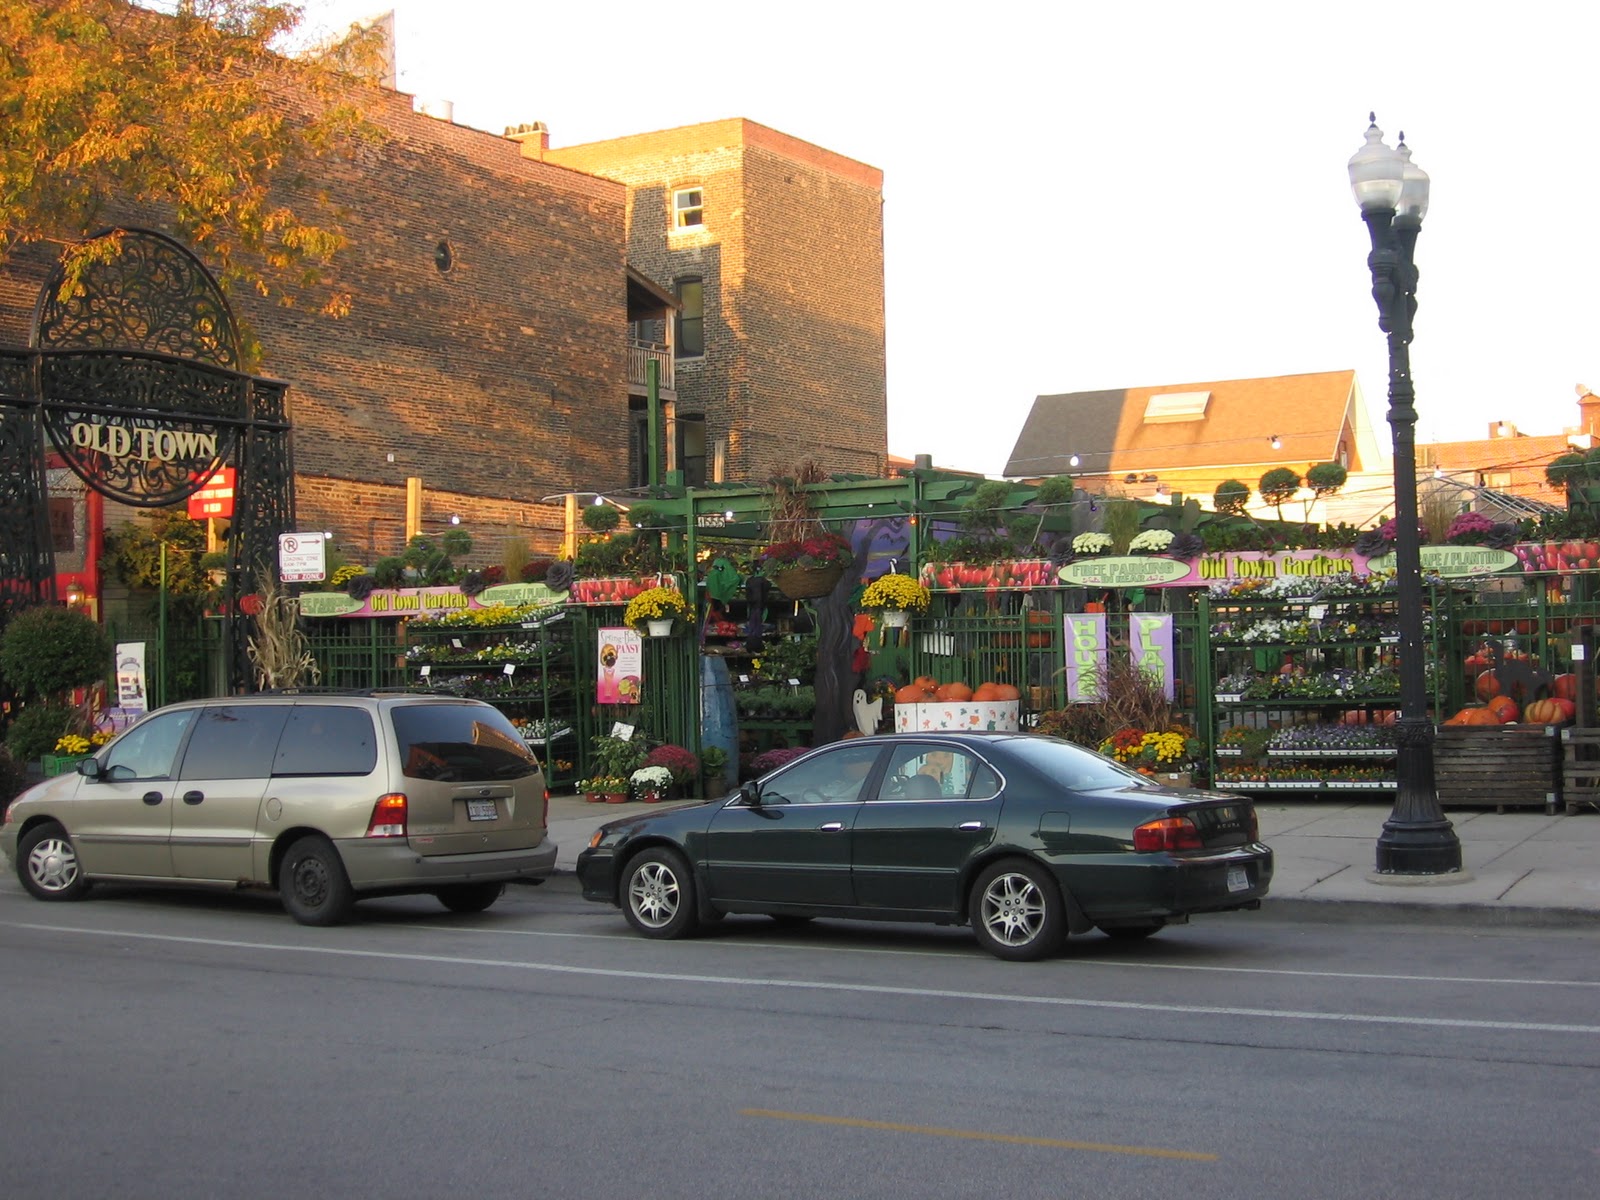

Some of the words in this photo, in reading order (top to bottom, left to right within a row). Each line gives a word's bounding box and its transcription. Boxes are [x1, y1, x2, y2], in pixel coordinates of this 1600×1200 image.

[72, 422, 131, 457] OLD
[134, 427, 218, 462] TOWN
[1450, 551, 1505, 566] PLANTING
[1072, 564, 1107, 577] FREE
[1110, 562, 1175, 575] PARKING
[1198, 556, 1227, 579] Old
[1232, 555, 1276, 579] Town
[1281, 555, 1354, 577] Gardens
[301, 572, 320, 580] ZONE
[1101, 575, 1114, 583] IN
[1115, 574, 1145, 583] REAR
[370, 593, 389, 612] Old
[392, 592, 420, 611] Town
[423, 591, 469, 610] Gardens
[616, 644, 639, 654] PANSY
